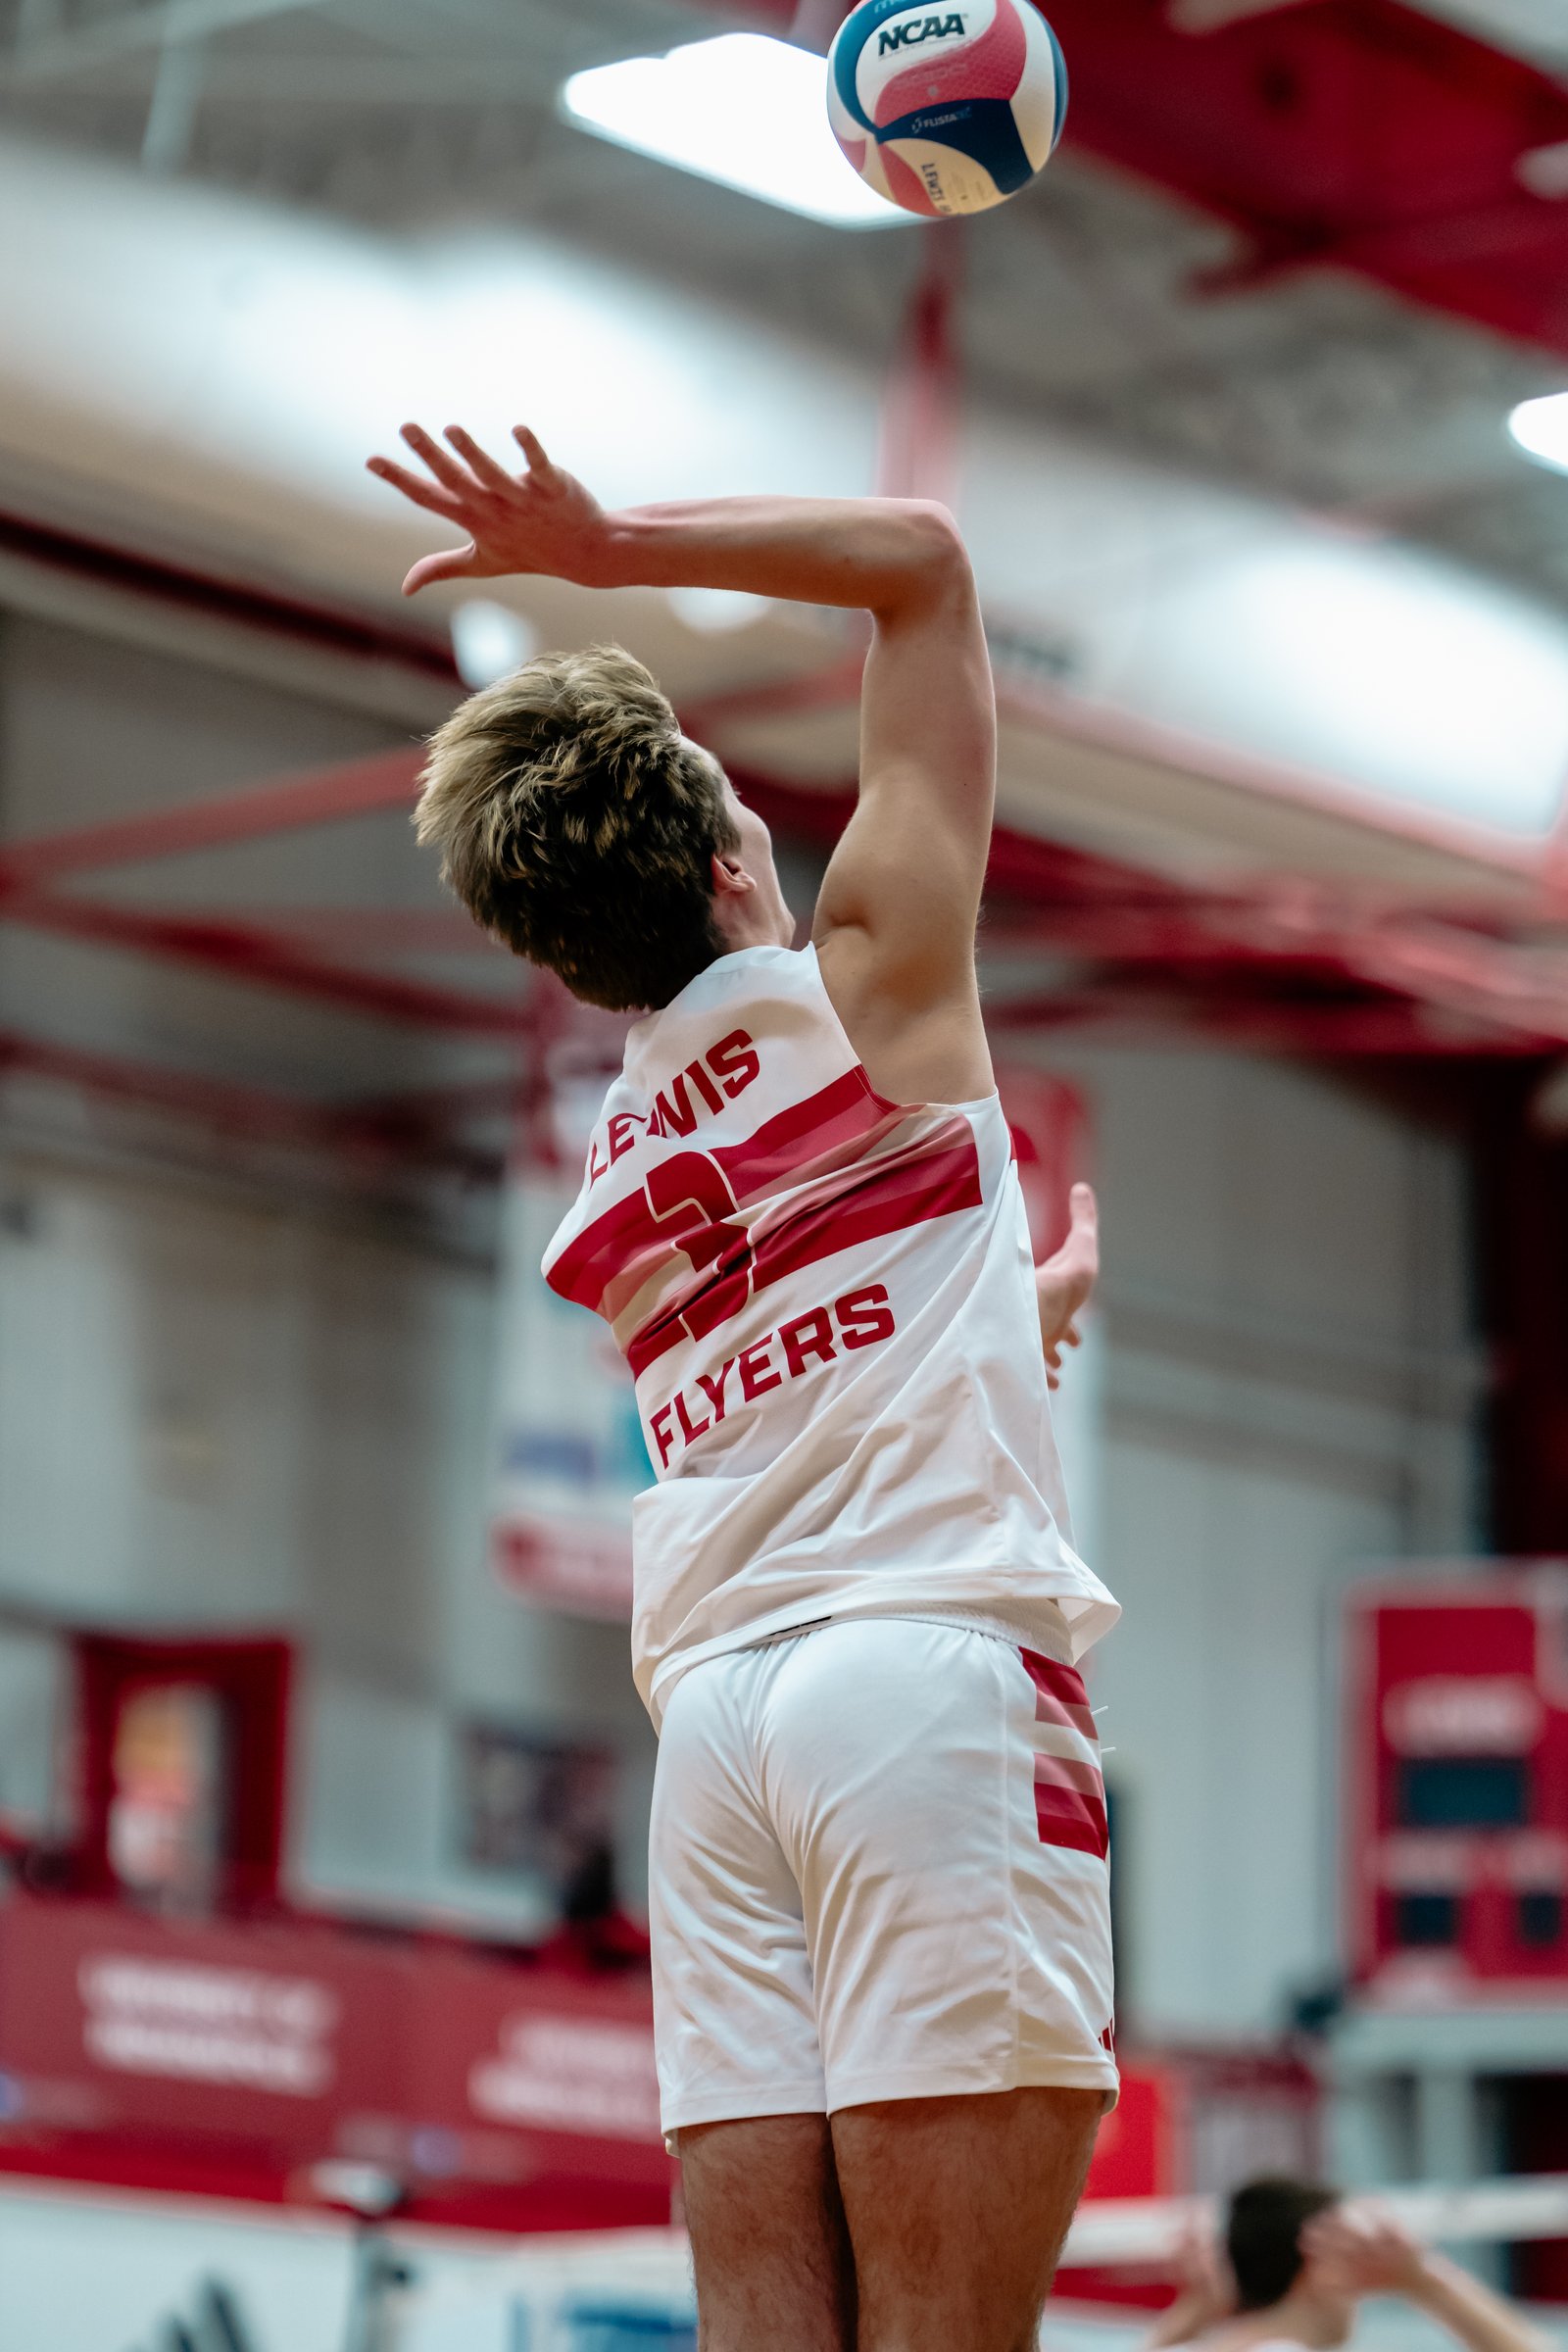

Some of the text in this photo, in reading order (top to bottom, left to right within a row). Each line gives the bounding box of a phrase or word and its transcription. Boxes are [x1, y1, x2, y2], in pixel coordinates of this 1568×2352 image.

[878, 13, 964, 56] NCAA
[590, 1029, 760, 1191] LEWIS
[650, 1284, 896, 1470] FLYERS
